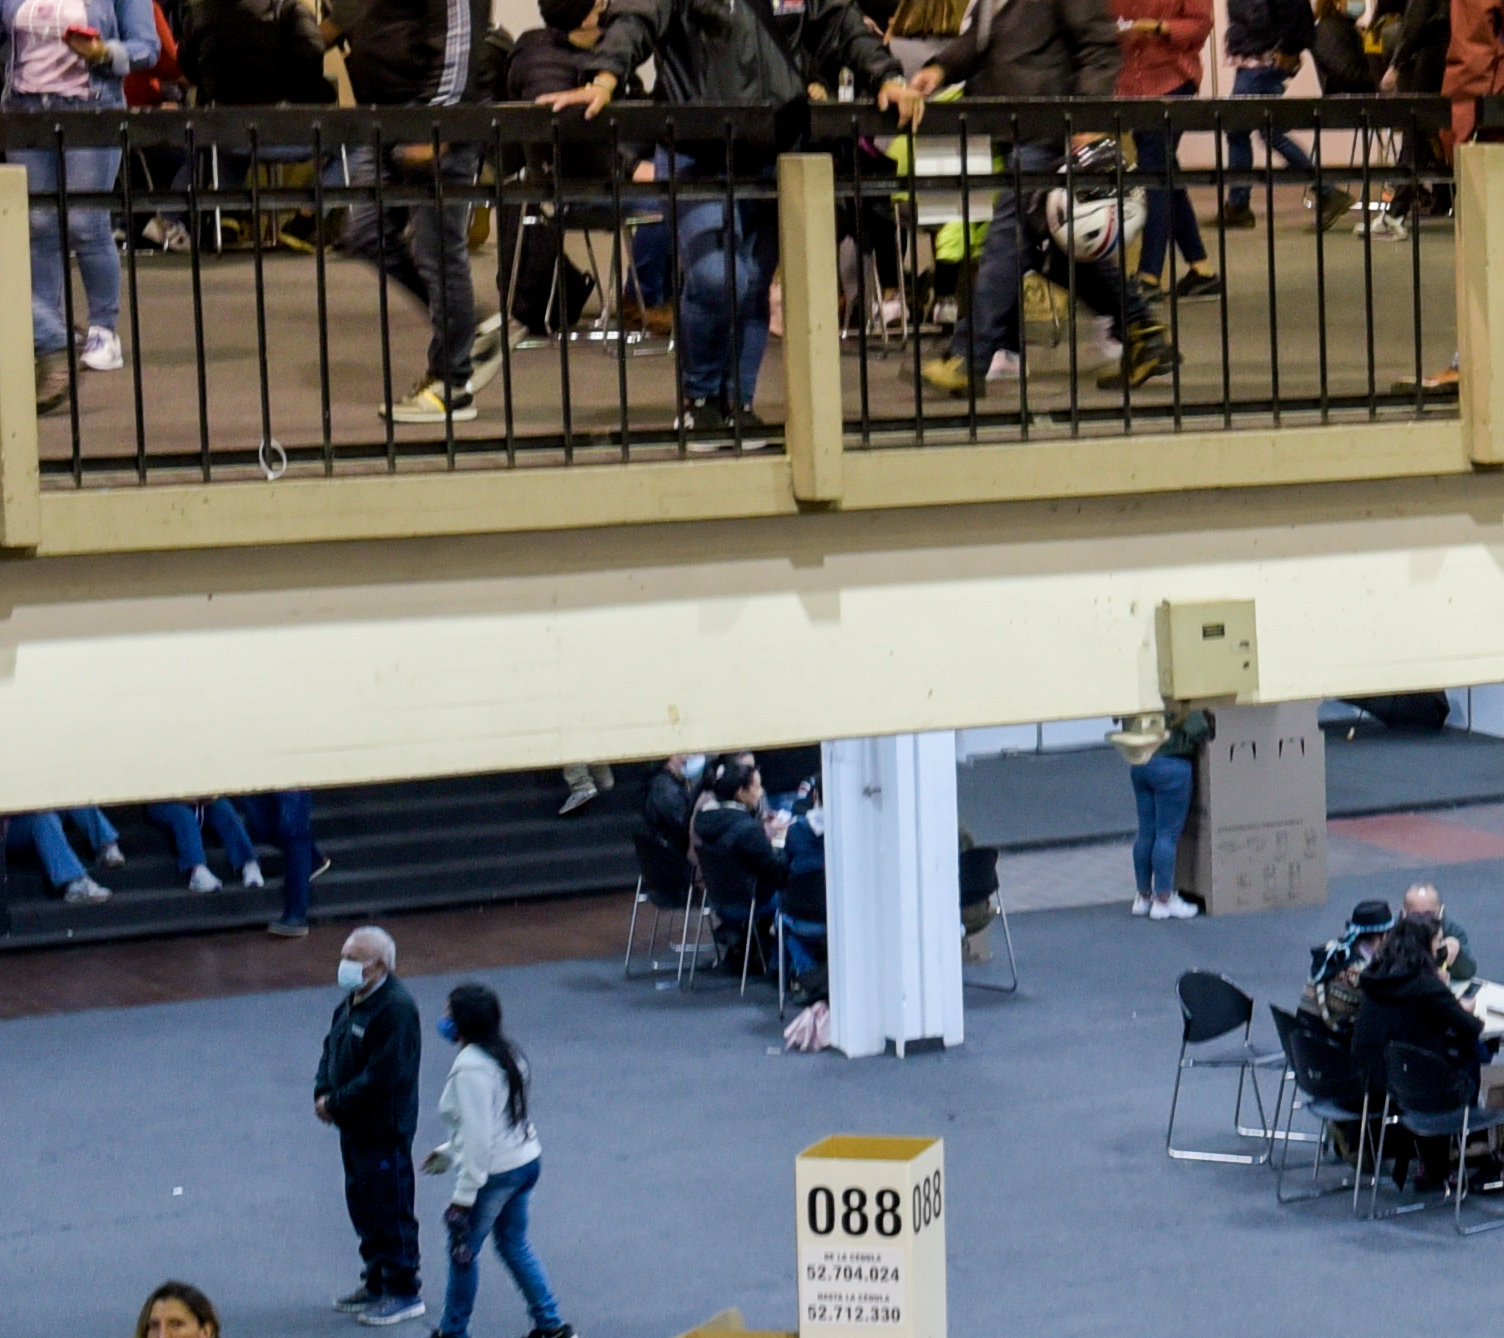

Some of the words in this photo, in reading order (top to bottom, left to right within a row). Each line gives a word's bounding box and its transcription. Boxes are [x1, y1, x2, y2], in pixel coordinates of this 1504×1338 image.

[807, 1186, 903, 1238] 088
[912, 1167, 943, 1235] 088
[806, 1265, 901, 1283] 52.704.024
[807, 1305, 902, 1325] 52.712.330
